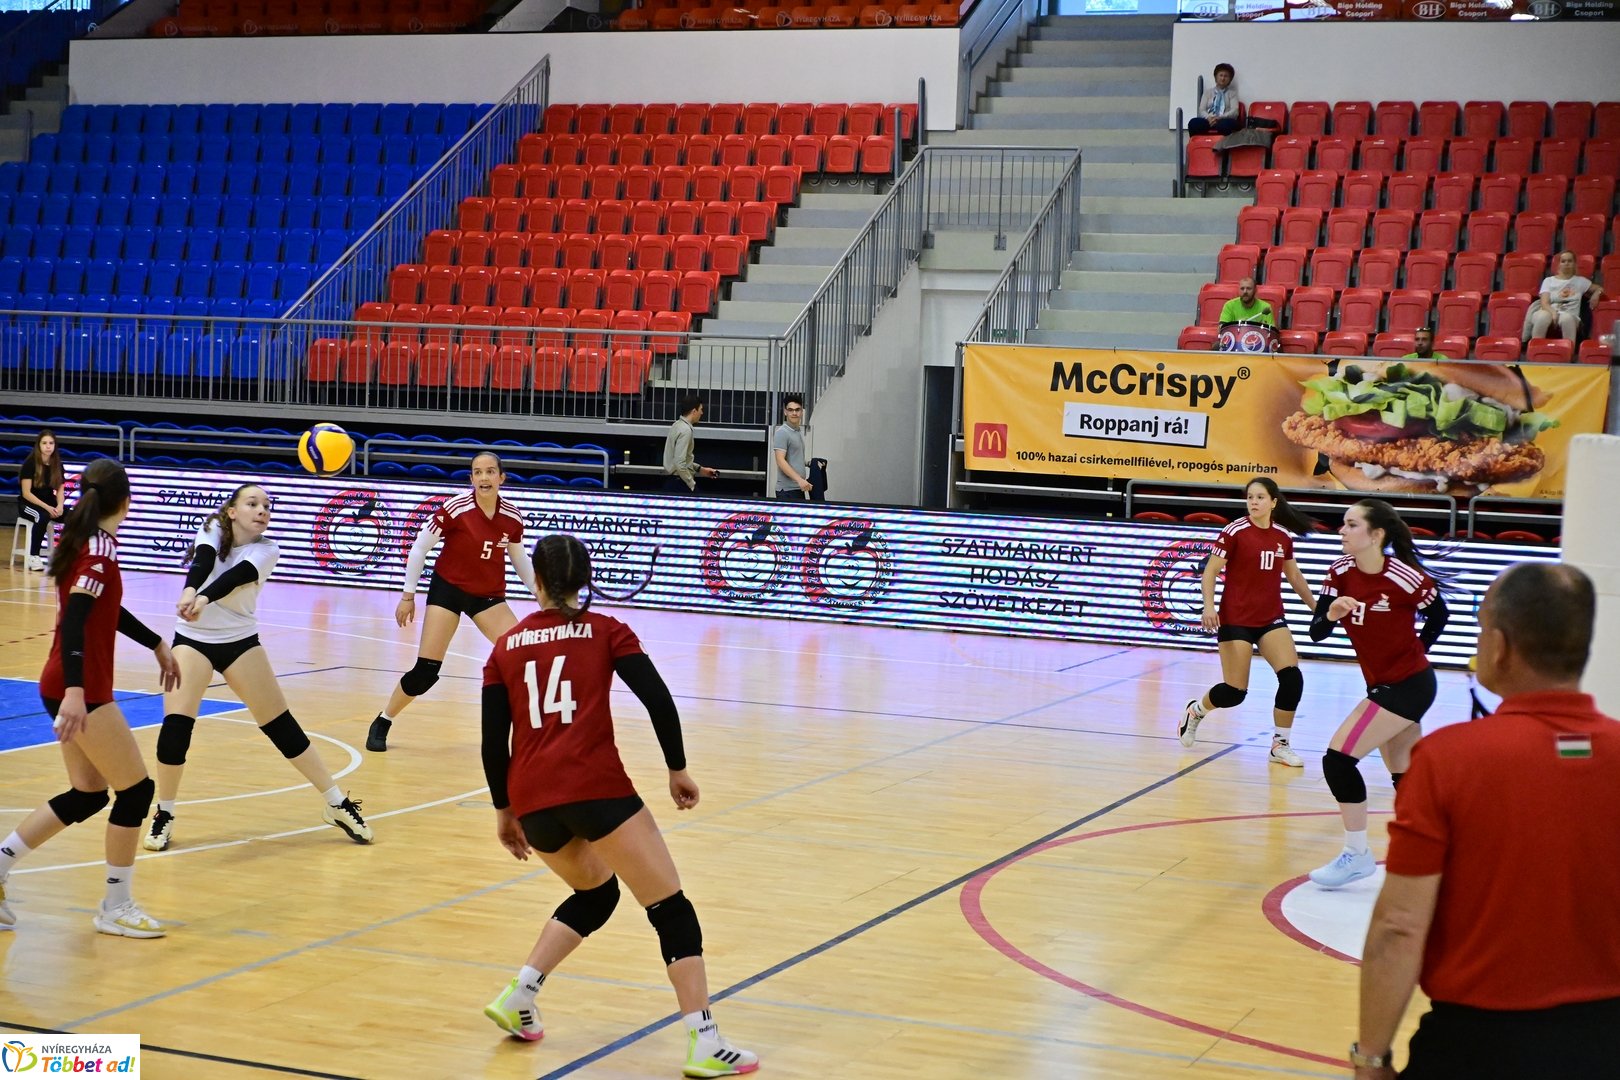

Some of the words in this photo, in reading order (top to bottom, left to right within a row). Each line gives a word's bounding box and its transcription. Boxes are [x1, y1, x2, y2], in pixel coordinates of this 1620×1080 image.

[1418, 4, 1440, 16] BH
[1534, 4, 1555, 15] BH
[1584, 1, 1613, 9] Holding
[1079, 414, 1159, 437] Roppanj
[1164, 416, 1189, 435] rá!
[1016, 451, 1046, 461] 100%
[1048, 452, 1077, 463] hazai
[1079, 454, 1175, 470] csirkemellfilével,
[1177, 460, 1224, 474] ropogós
[1226, 461, 1278, 475] panírban
[525, 512, 663, 535] SZATMÁRKERT
[480, 540, 494, 560] 5
[941, 538, 1097, 564] SZATMÁRKERT
[1260, 550, 1275, 570] 10
[969, 565, 1061, 589] HODÁSZ
[938, 588, 1089, 617] SZÖVETKEZET
[1351, 601, 1366, 626] 9
[506, 621, 593, 651] NYÍREGYHÁZA
[523, 655, 577, 729] 14
